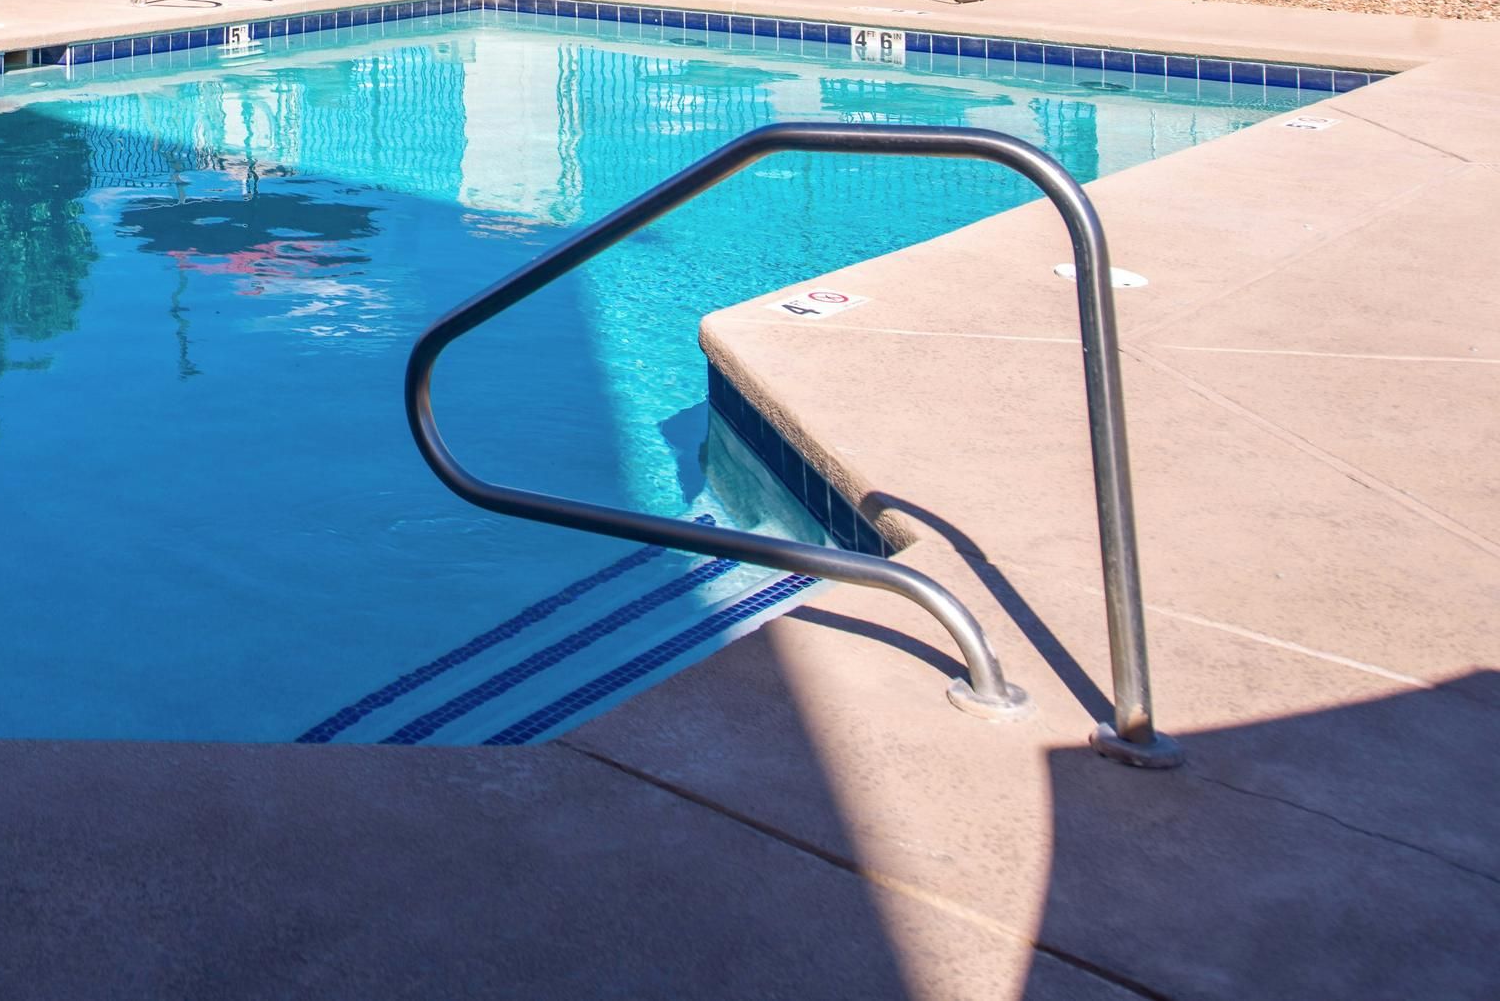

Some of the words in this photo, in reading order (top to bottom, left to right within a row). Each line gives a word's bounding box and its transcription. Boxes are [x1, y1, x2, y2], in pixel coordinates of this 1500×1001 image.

[232, 27, 240, 44] 5
[855, 30, 867, 46] 4
[881, 32, 892, 49] 6
[781, 304, 821, 315] 4
